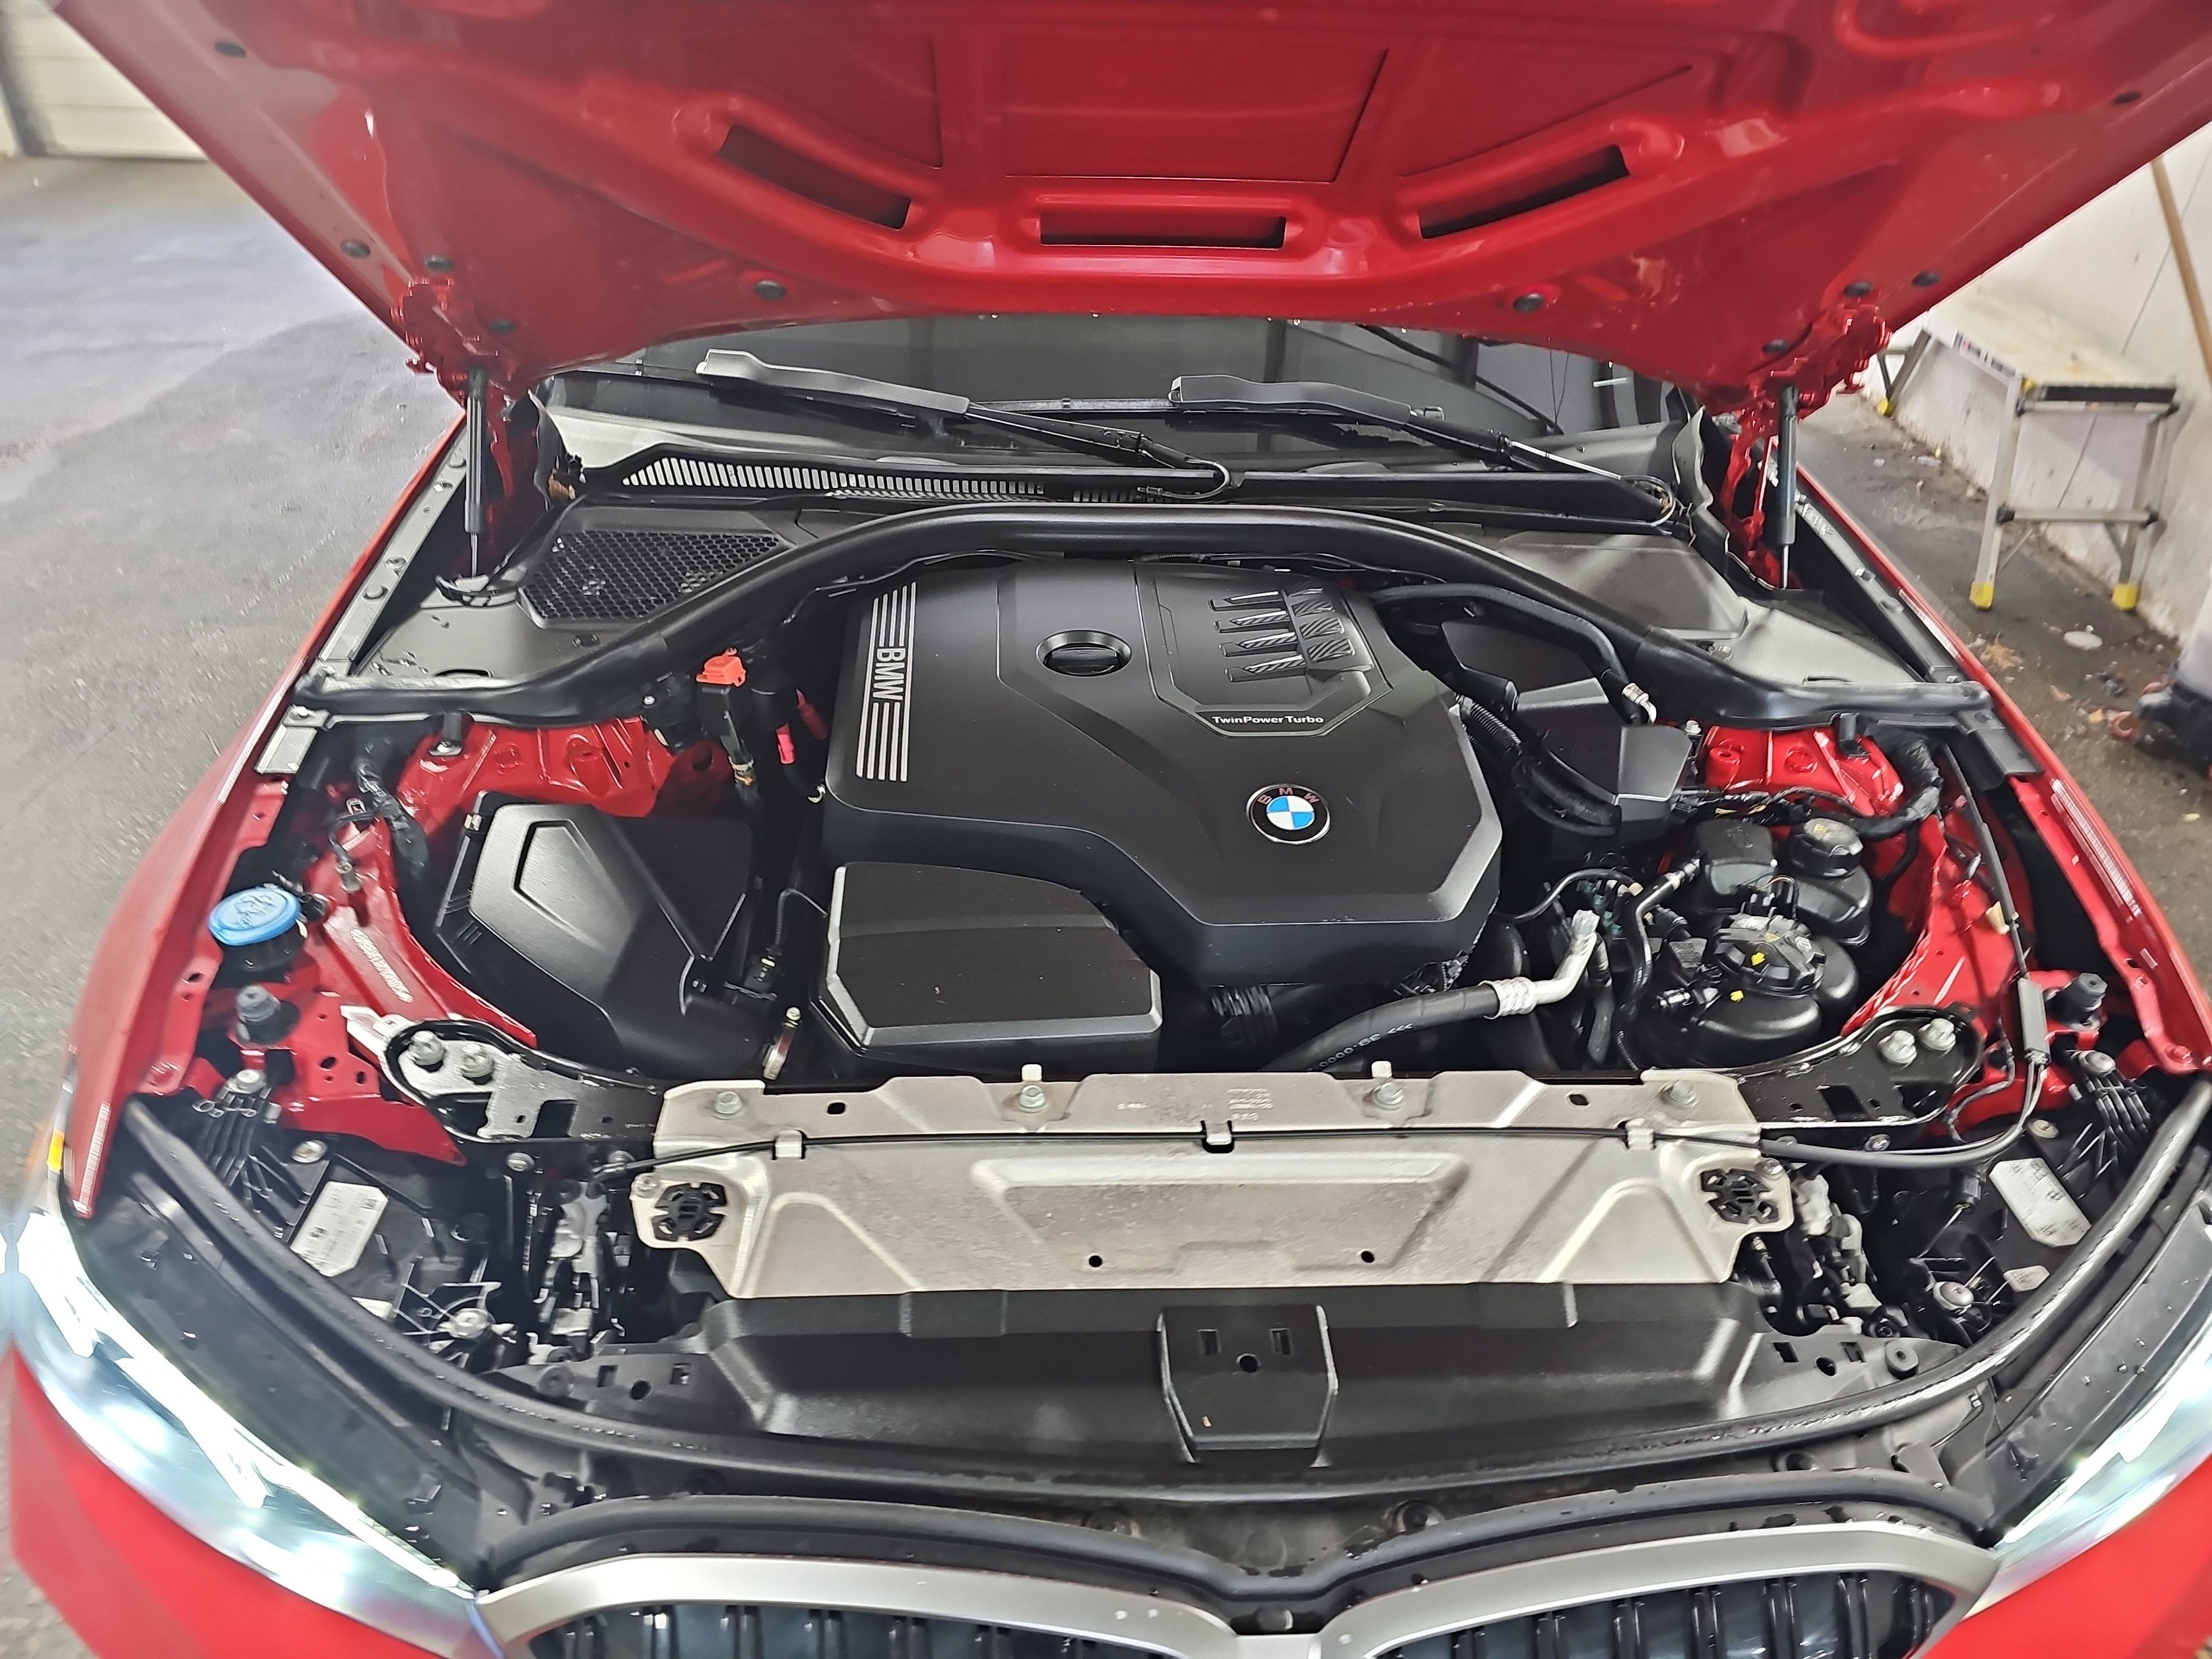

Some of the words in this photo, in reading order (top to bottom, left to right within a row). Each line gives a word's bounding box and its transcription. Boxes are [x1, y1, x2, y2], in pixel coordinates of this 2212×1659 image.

[872, 648, 905, 700] BMW
[1212, 716, 1283, 724] TwinPower
[1285, 715, 1324, 723] Turbo
[1257, 787, 1320, 805] BMW
